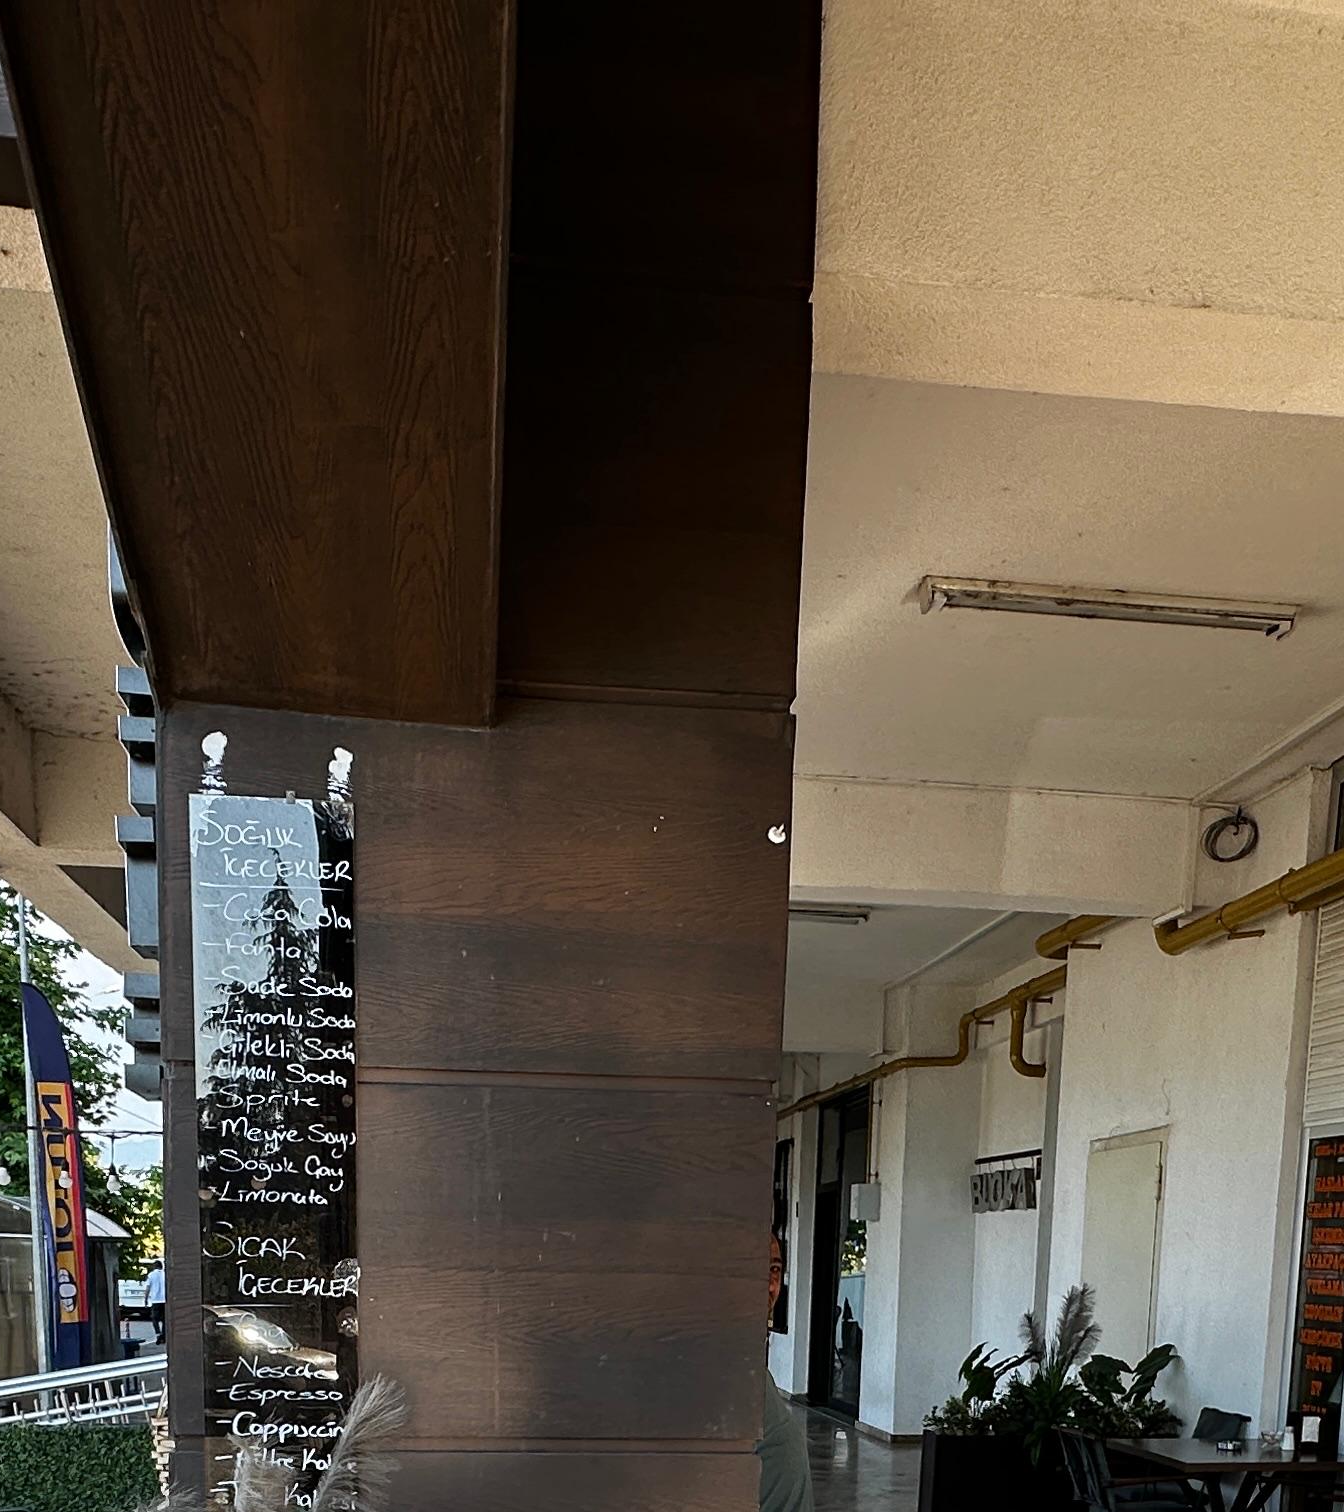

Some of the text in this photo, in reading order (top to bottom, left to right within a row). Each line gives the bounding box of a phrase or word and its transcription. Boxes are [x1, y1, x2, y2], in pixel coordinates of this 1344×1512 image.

[223, 893, 352, 930] Coca Cola
[225, 932, 301, 959] Fanta
[222, 966, 353, 998] Sade Soda
[221, 1002, 356, 1029] Limonlu Soda
[302, 1038, 356, 1065] Soda
[286, 1064, 347, 1088] Soda
[215, 1084, 320, 1114] Sprite
[221, 1116, 304, 1154] Meyve
[219, 1148, 300, 1181] Soğuk
[218, 1181, 328, 1205] Limonata
[203, 1221, 305, 1260] SICAK
[229, 1383, 343, 1407] Espresso
